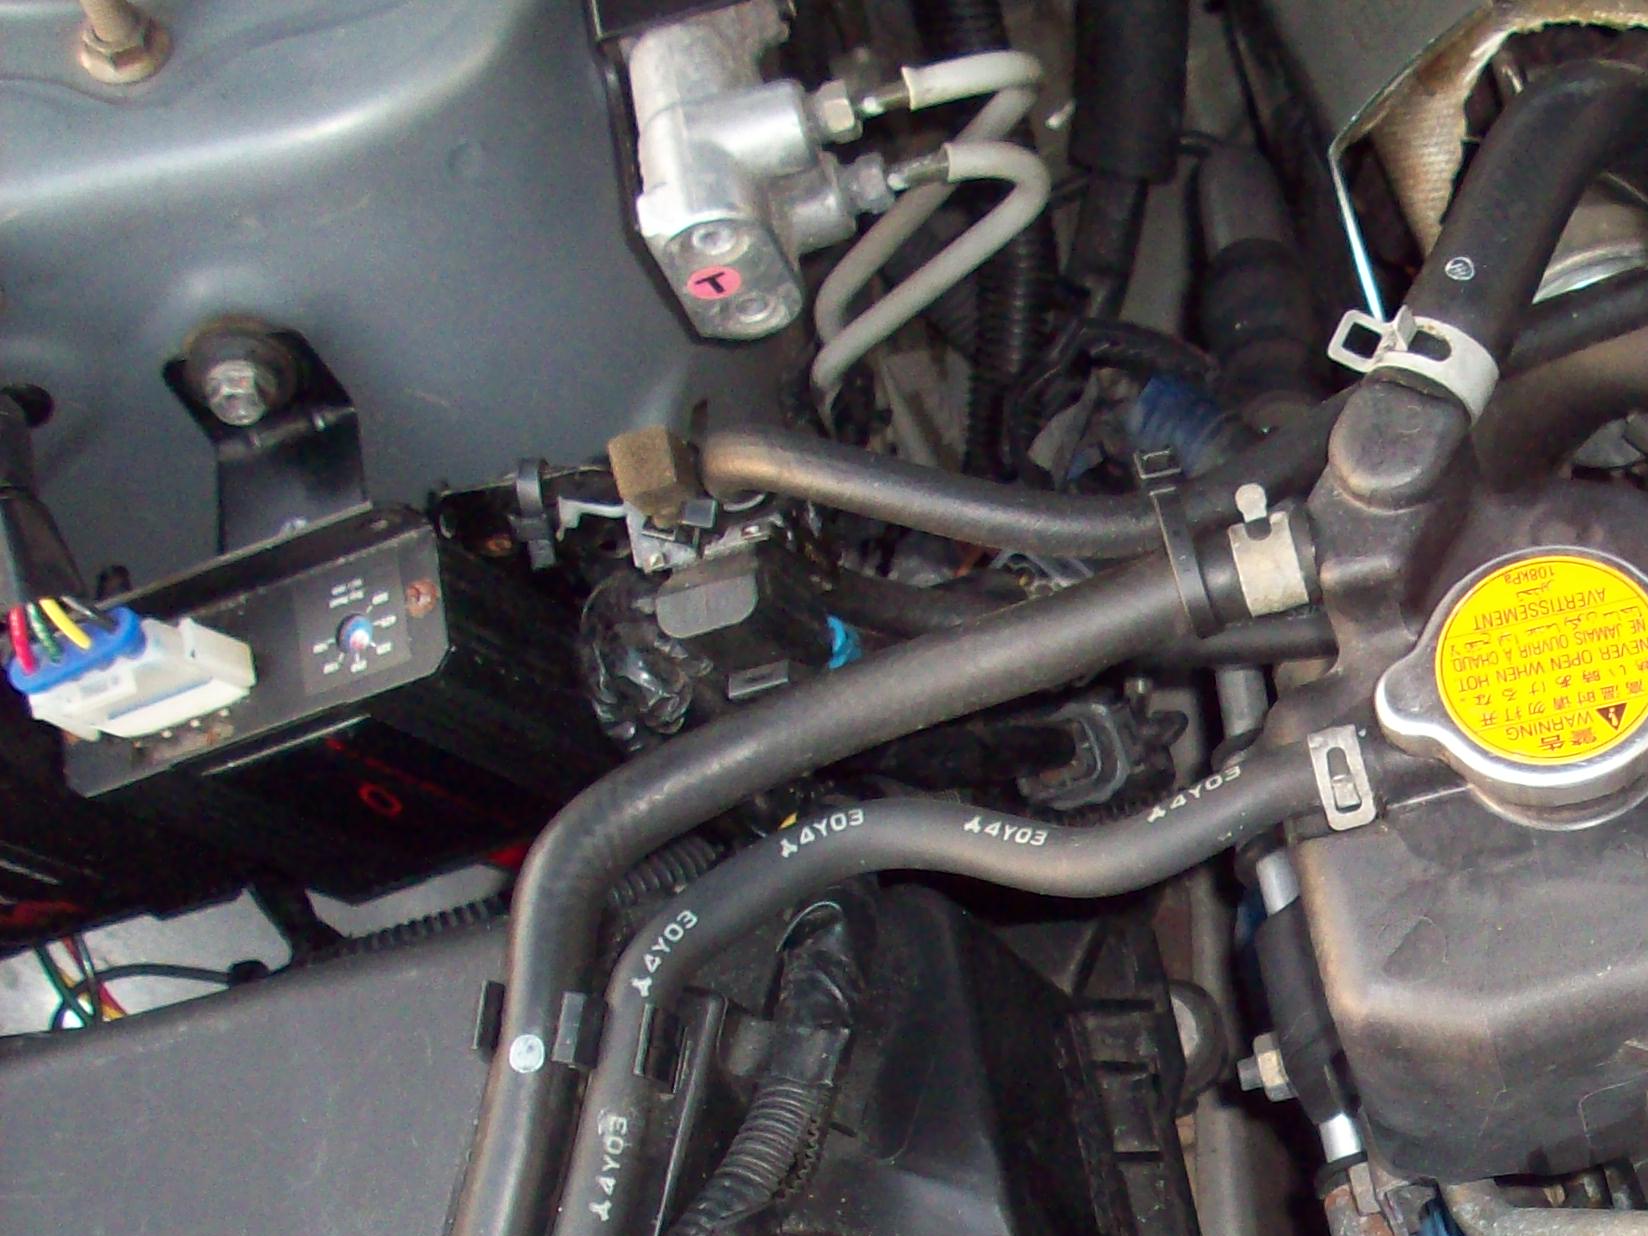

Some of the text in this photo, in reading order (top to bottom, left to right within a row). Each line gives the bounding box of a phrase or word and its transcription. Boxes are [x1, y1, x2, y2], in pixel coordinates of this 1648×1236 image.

[694, 271, 725, 294] T
[1504, 565, 1555, 584] 108kPa
[1474, 588, 1606, 631] AVERTISSEMENT
[1576, 624, 1622, 644] JAMAIS
[1631, 618, 1646, 635] NE
[1520, 634, 1569, 659] OUVRIR
[1497, 661, 1544, 682] WHEN
[1551, 652, 1593, 670] OPEN
[1506, 710, 1594, 741] WARNING
[1538, 728, 1597, 752] 警告
